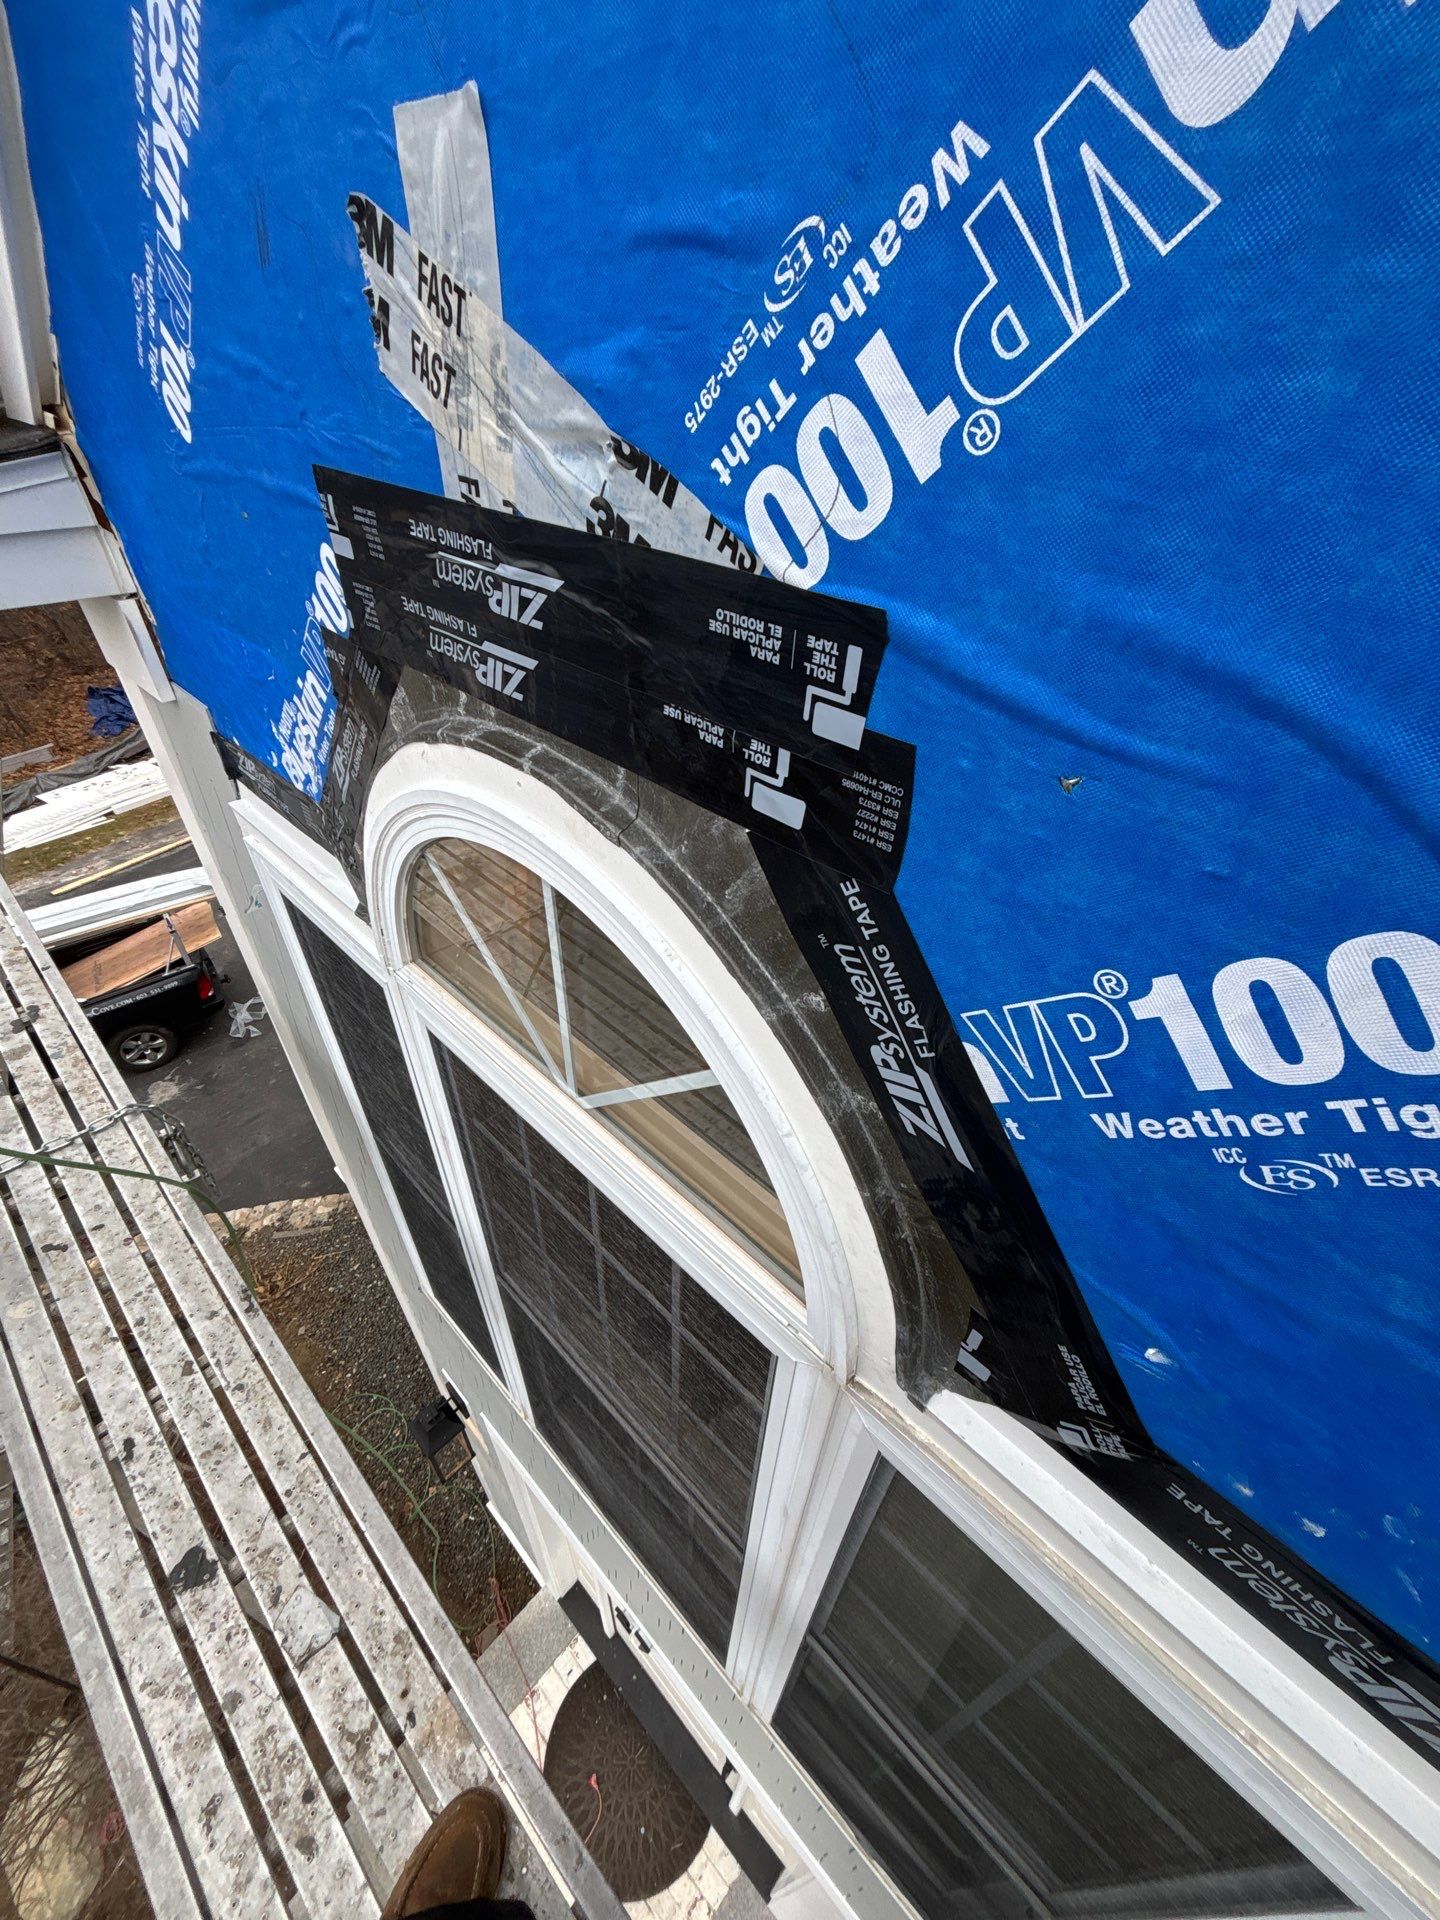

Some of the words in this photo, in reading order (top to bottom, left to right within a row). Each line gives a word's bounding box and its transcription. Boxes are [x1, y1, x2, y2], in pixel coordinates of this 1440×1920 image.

[147, 0, 190, 250] eskin
[800, 119, 991, 377] Weather
[823, 223, 853, 269] ICC
[417, 249, 467, 338] FAST
[160, 317, 192, 444] 100
[411, 329, 457, 409] FAST
[683, 319, 761, 434] ESR-2975
[710, 377, 798, 485] Tight
[744, 328, 961, 590] 100
[408, 518, 437, 542] TAPE
[438, 527, 493, 560] FLASHING
[401, 595, 427, 618] TAPE
[488, 581, 548, 631] ZIP
[429, 608, 478, 637] FLASHING
[708, 618, 730, 635] USE
[715, 607, 765, 633] RODILLO
[767, 624, 783, 638] EL
[732, 626, 782, 652] APLICAR
[807, 634, 839, 656] TAPE
[749, 644, 780, 665] PARA
[811, 650, 838, 669] THE
[475, 656, 527, 701] ZIP
[803, 661, 836, 683] ROLL
[662, 703, 683, 720] USE
[684, 709, 725, 737] APLICAR
[698, 728, 724, 749] PARA
[749, 738, 772, 756] THE
[742, 747, 771, 768] ROLL
[877, 779, 905, 797] CCMC
[886, 793, 902, 808] ULC
[880, 817, 898, 831] ESR
[881, 805, 900, 819] ESR
[852, 830, 875, 845] #1473
[875, 839, 893, 853] ESR
[877, 828, 895, 842] ESR
[839, 877, 880, 942] TAPE
[872, 943, 935, 1059] FLASHING
[1127, 930, 1440, 1092] 100
[869, 1044, 946, 1149] ZIP
[1090, 1108, 1309, 1140] Weather
[1212, 1147, 1247, 1166] ICC
[1057, 1343, 1075, 1367] USE
[1068, 1368, 1098, 1414] APLICAR
[1071, 1354, 1100, 1401] RODILLO
[1067, 1382, 1088, 1411] PARA
[1094, 1402, 1108, 1417] EL
[1166, 1482, 1234, 1542] TAPE
[1240, 1542, 1394, 1666] FLASHING
